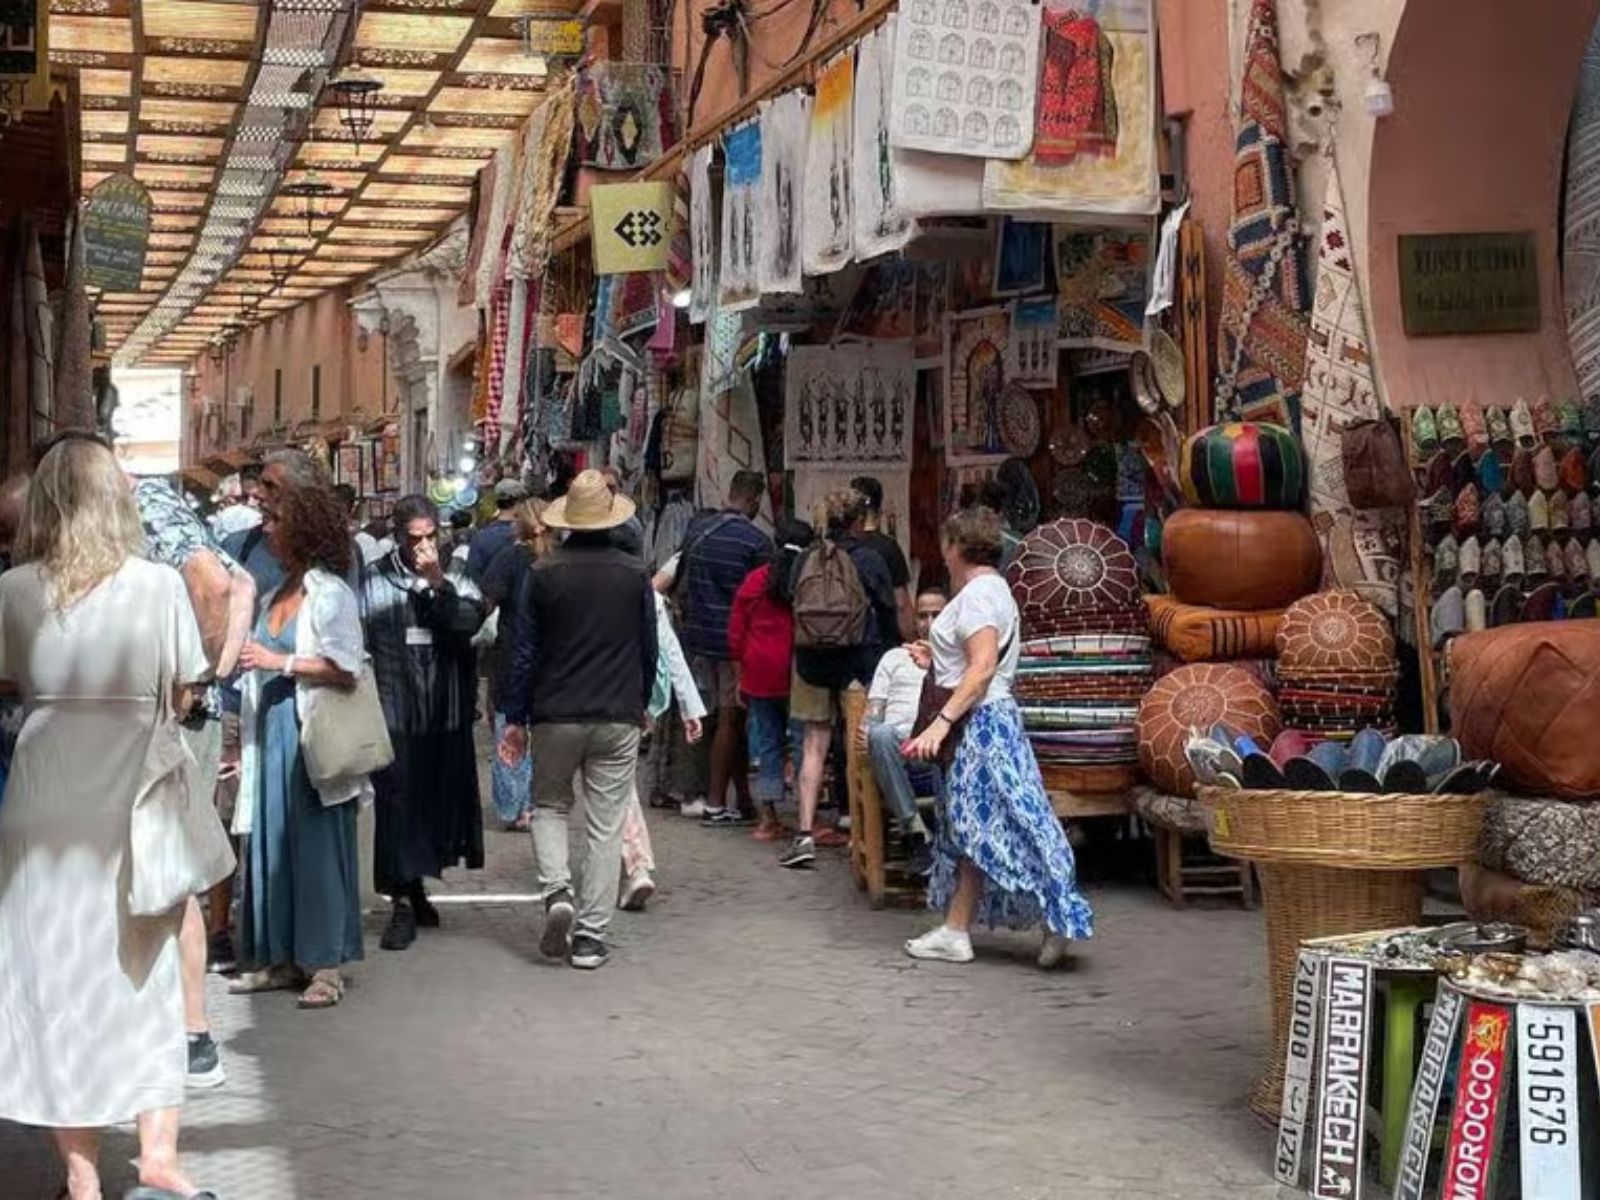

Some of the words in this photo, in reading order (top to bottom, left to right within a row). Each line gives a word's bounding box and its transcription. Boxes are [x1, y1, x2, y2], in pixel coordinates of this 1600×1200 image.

[1322, 963, 1365, 1164] MARRAKECH
[1452, 1059, 1496, 1200] MOROCCO
[1527, 1022, 1567, 1146] 591676
[1277, 1126, 1298, 1178] 126
